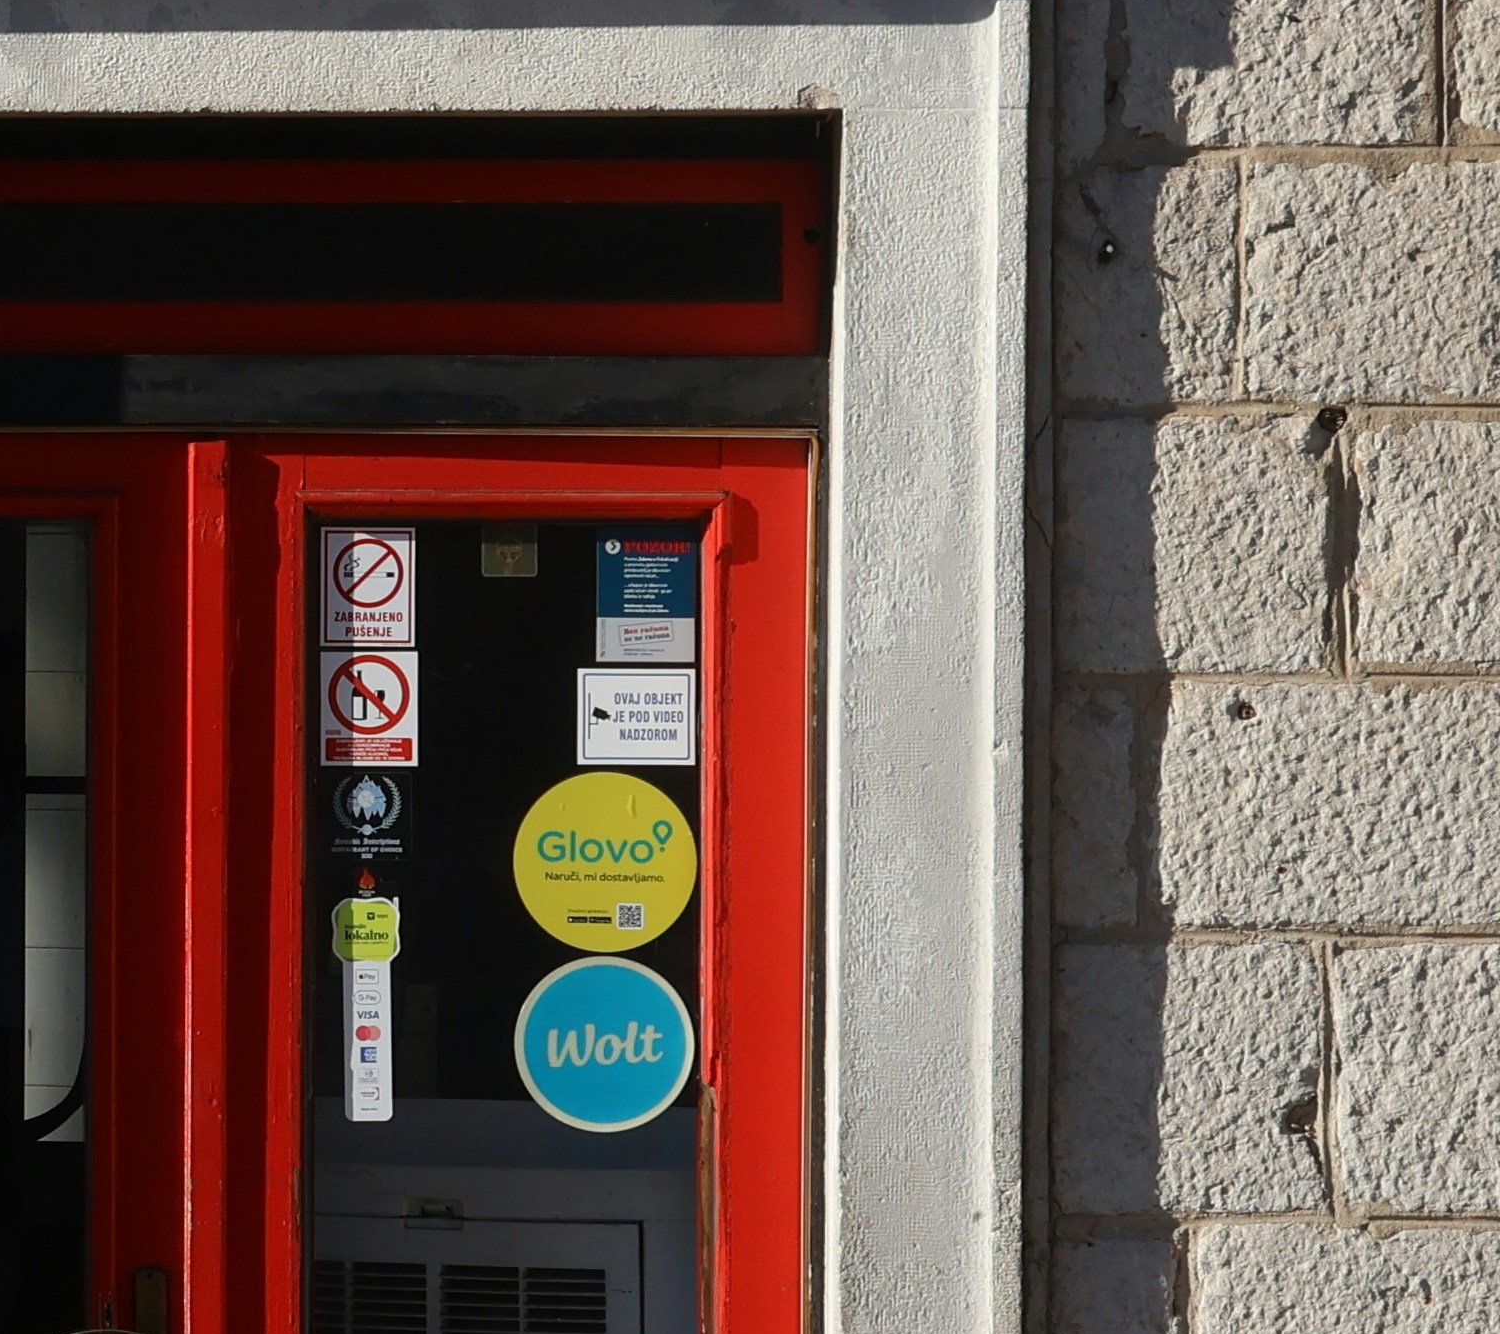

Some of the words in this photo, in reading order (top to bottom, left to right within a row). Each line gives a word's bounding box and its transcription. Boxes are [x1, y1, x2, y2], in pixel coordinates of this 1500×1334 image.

[334, 611, 403, 623] ZABRANJENO
[345, 625, 392, 637] PUŠENJE
[614, 692, 641, 705] OVAJ
[644, 692, 683, 705] OBJEKT
[613, 710, 625, 723] JE
[629, 710, 650, 723] POD
[653, 710, 684, 723] VIDEO
[619, 728, 678, 741] NADZOROM
[537, 830, 654, 864] Glovo
[545, 871, 582, 883] Naruči,
[584, 872, 598, 882] mi
[600, 872, 665, 884] dostavljamo.
[345, 930, 389, 941] lokalno
[357, 1011, 380, 1019] VISA
[547, 1020, 663, 1068] Wolt
